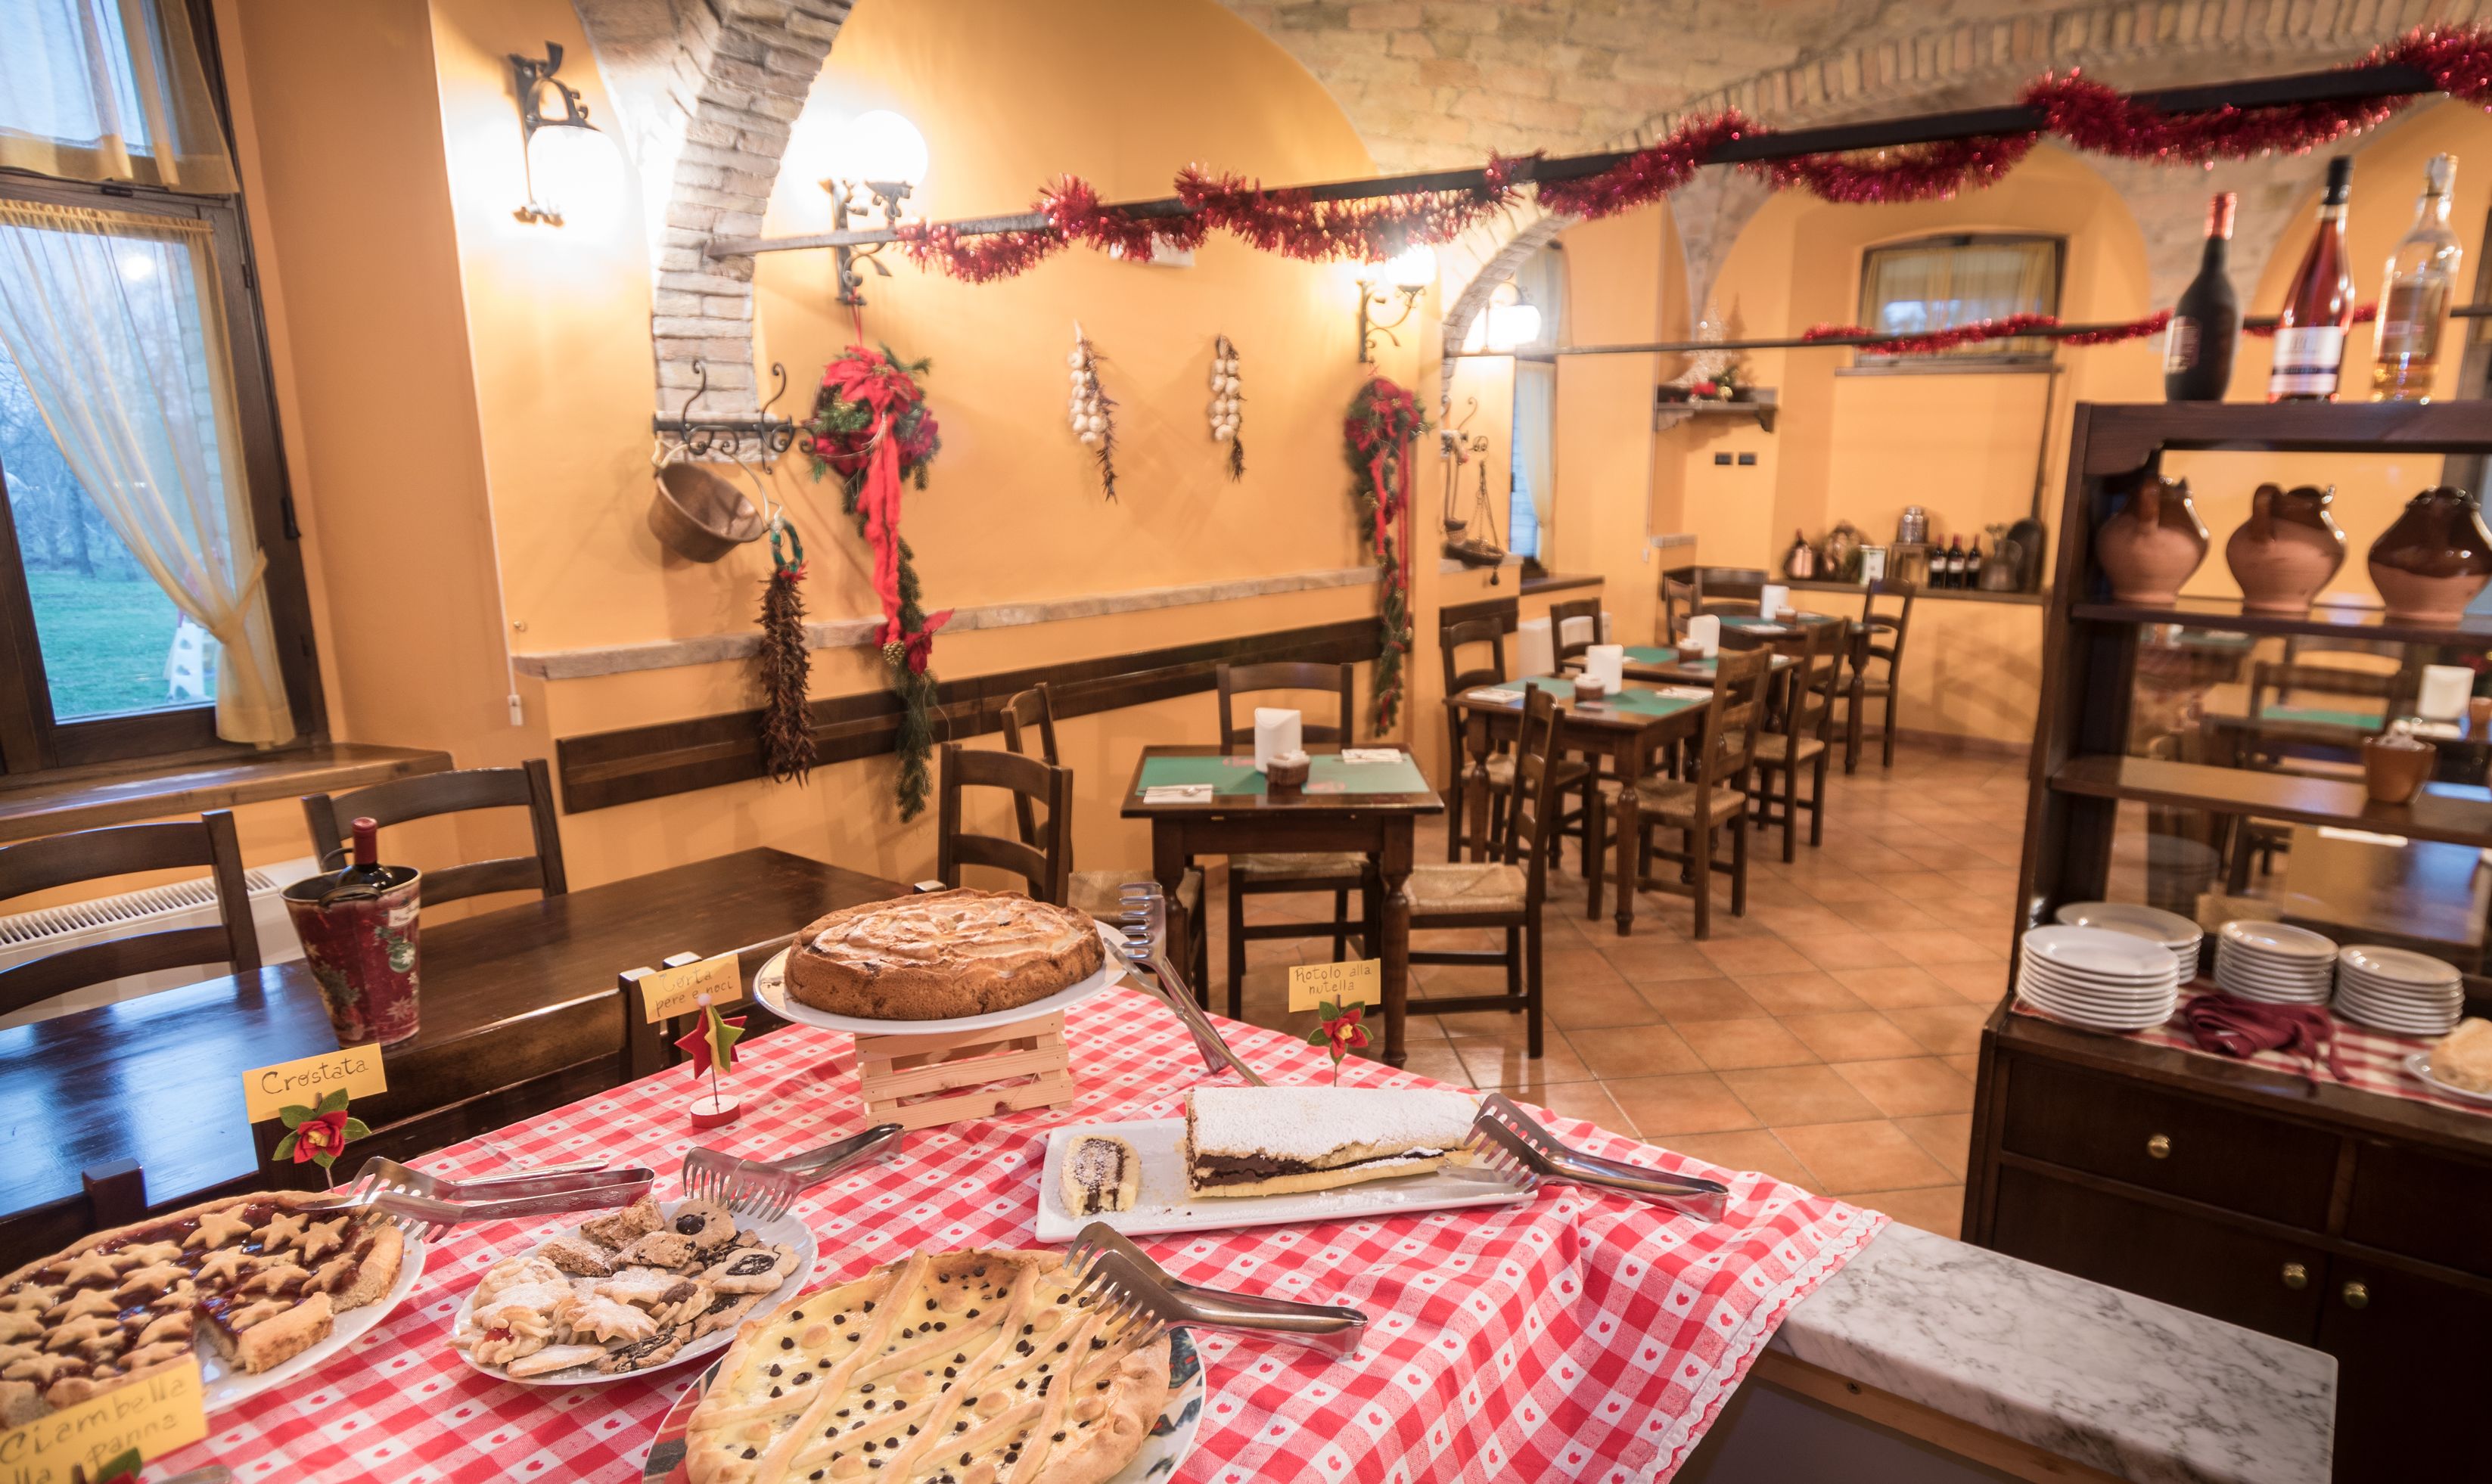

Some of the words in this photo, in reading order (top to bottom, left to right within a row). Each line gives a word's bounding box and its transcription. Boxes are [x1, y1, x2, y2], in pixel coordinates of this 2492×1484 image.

[658, 967, 713, 992] Torta
[1294, 966, 1341, 983] Rotolo
[1349, 964, 1372, 977] alla
[655, 995, 686, 1017] pere
[692, 990, 700, 999] e
[706, 976, 733, 997] noci
[1309, 980, 1355, 995] nutella
[261, 1057, 369, 1094] Crostata
[0, 1376, 188, 1464] Ciambella
[14, 1462, 56, 1484] lla
